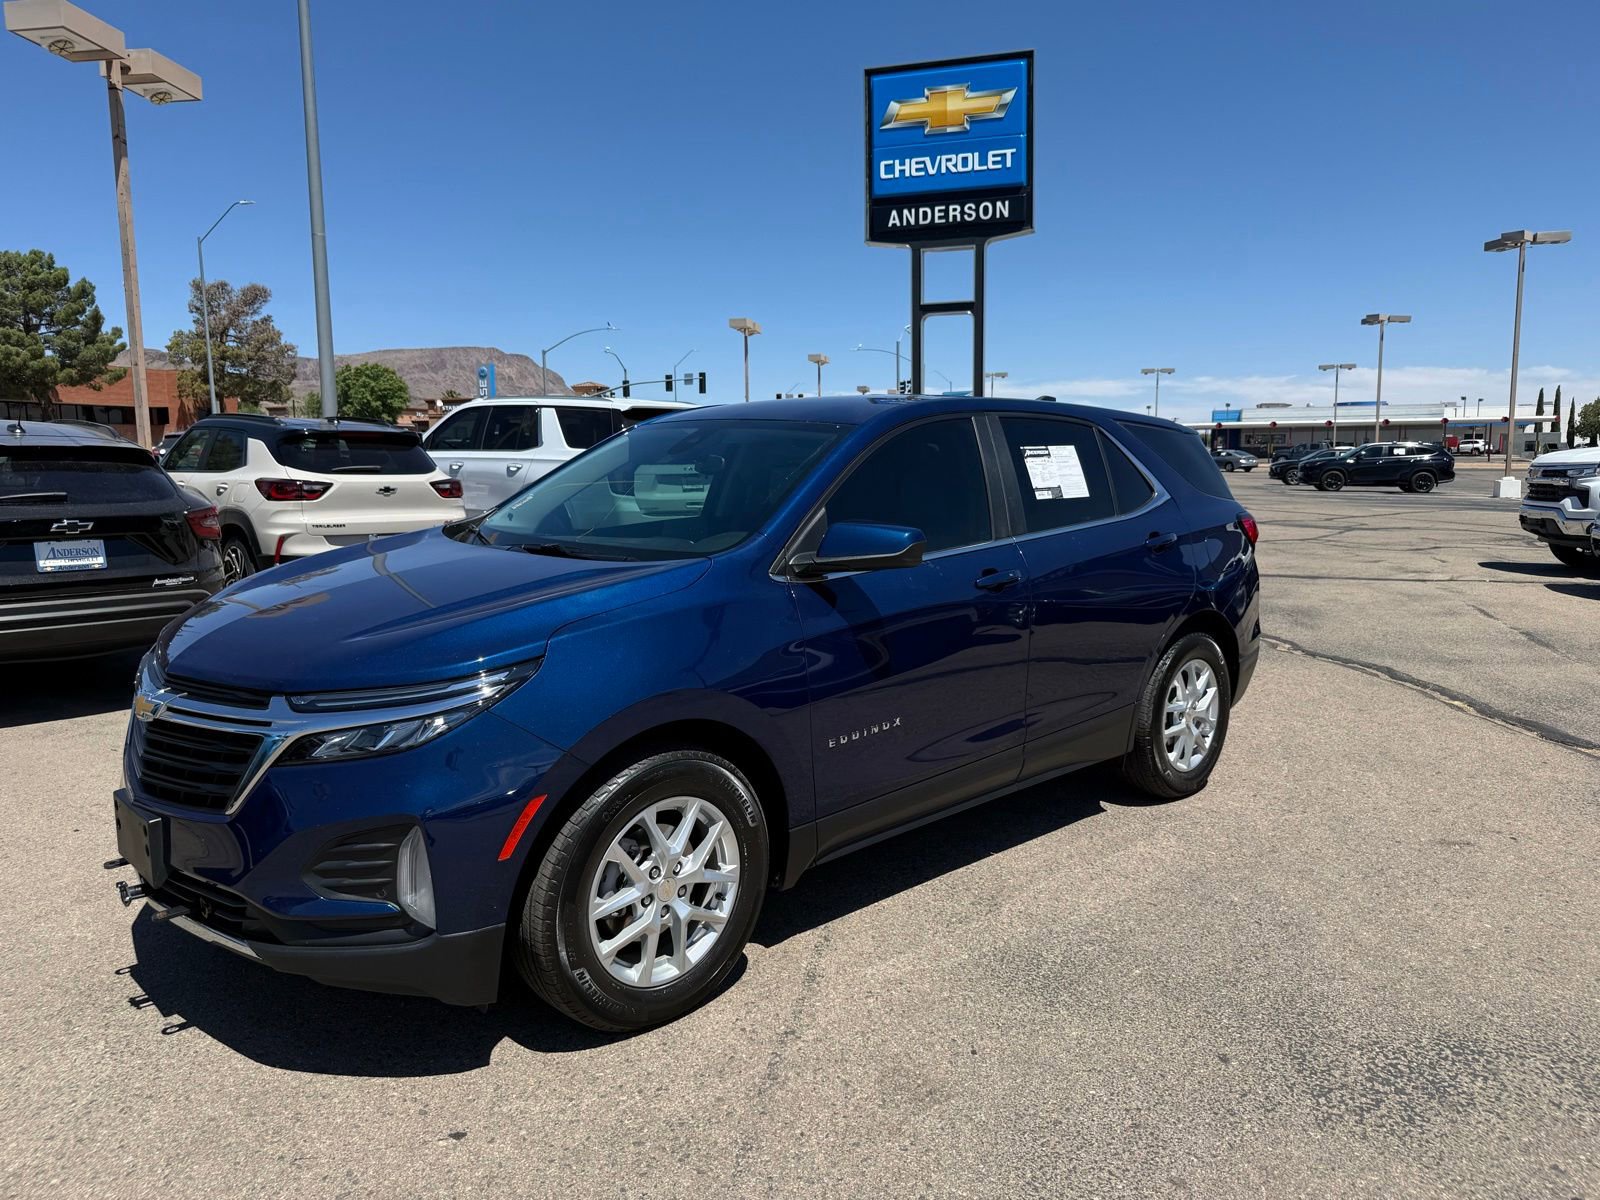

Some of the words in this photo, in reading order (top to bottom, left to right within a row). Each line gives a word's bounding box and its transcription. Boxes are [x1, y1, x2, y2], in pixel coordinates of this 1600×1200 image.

[879, 148, 1017, 180] CHEVROLET
[887, 200, 1010, 228] ANDERSON
[46, 547, 100, 560] ANDERSON
[828, 717, 901, 748] EQUINOX
[720, 776, 759, 825] MICHELIN
